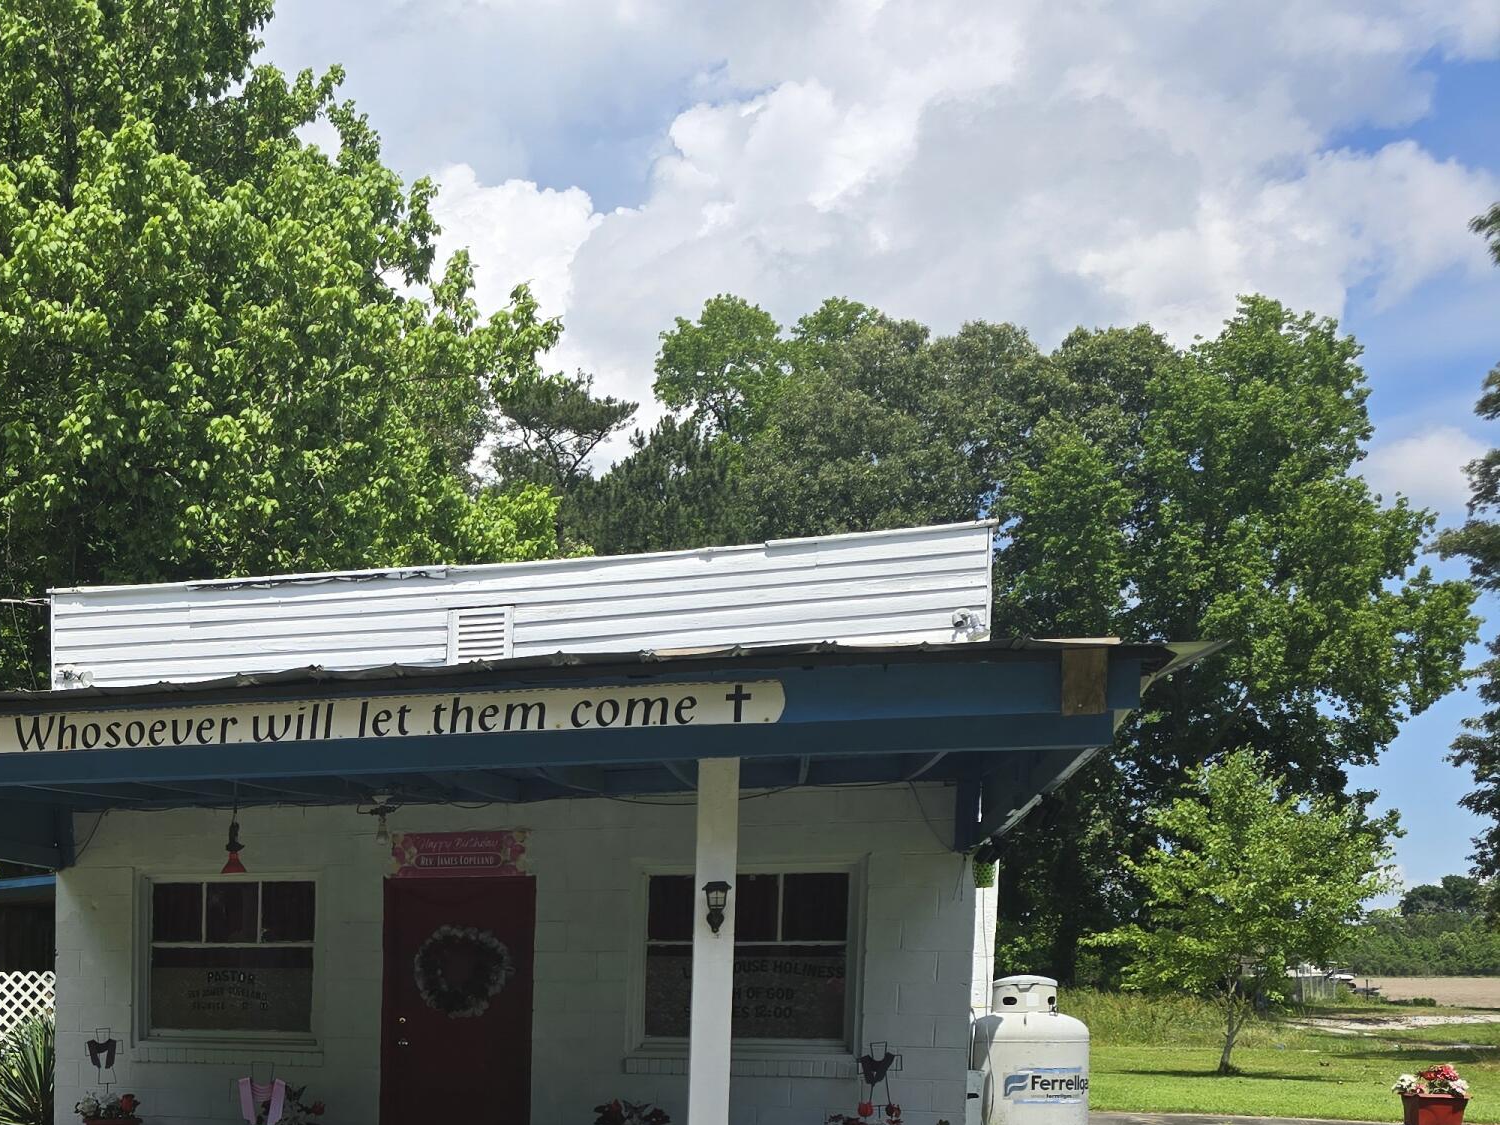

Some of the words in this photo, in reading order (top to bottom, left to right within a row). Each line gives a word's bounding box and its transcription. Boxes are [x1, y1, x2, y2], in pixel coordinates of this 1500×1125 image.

[14, 714, 238, 752] Whosoever
[252, 702, 335, 742] will
[358, 700, 412, 738] let
[432, 696, 546, 735] them
[570, 695, 698, 729] come
